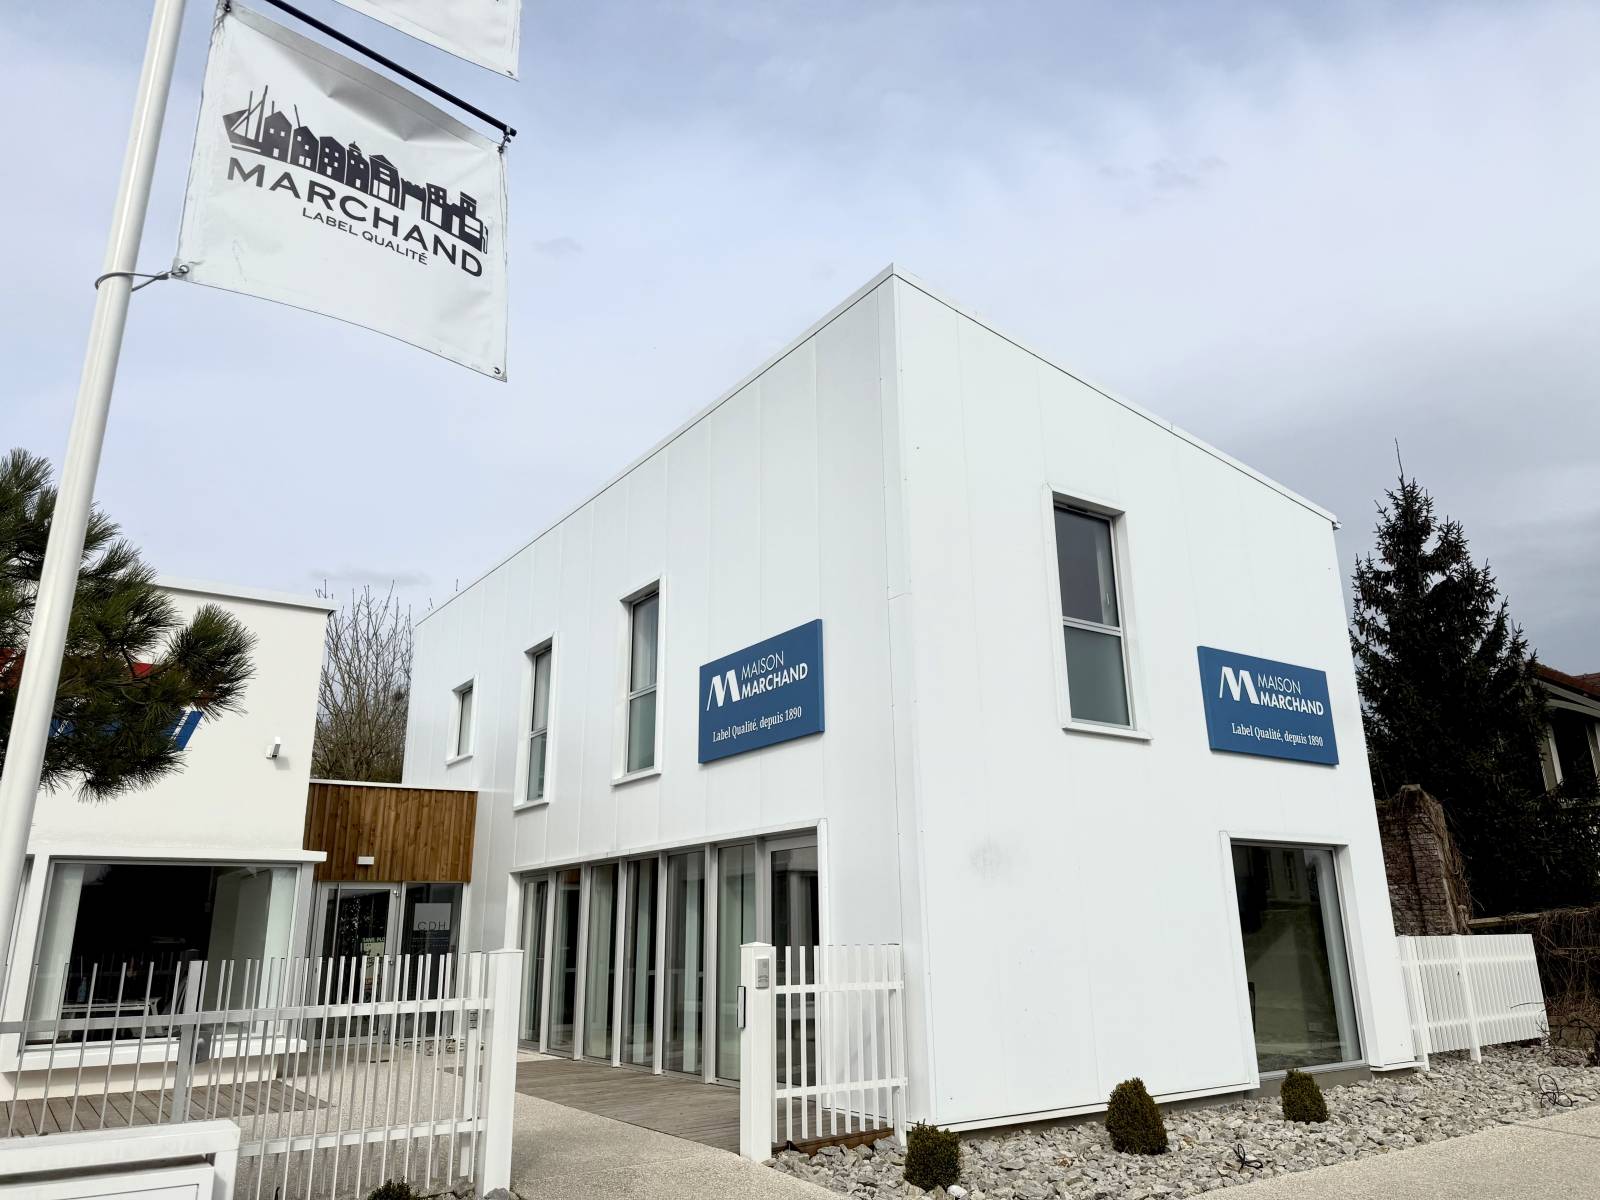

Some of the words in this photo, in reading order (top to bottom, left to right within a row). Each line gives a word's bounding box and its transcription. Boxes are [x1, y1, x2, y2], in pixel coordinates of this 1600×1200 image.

[227, 156, 483, 278] MARCHAND
[302, 207, 358, 236] LABEL
[362, 230, 428, 266] QUALITÉ
[741, 650, 784, 681] MAISON
[741, 662, 809, 700] MARCHAND
[1257, 672, 1302, 695] MAISON
[1260, 690, 1324, 716] MARCHAND
[712, 726, 731, 743] Label
[731, 719, 759, 739] Qualité,
[759, 711, 784, 729] depuis
[784, 705, 802, 722] 1890
[1231, 722, 1253, 737] Label
[1254, 726, 1284, 743] Qualité,
[1284, 730, 1308, 746] depuis
[1308, 733, 1324, 747] 1890
